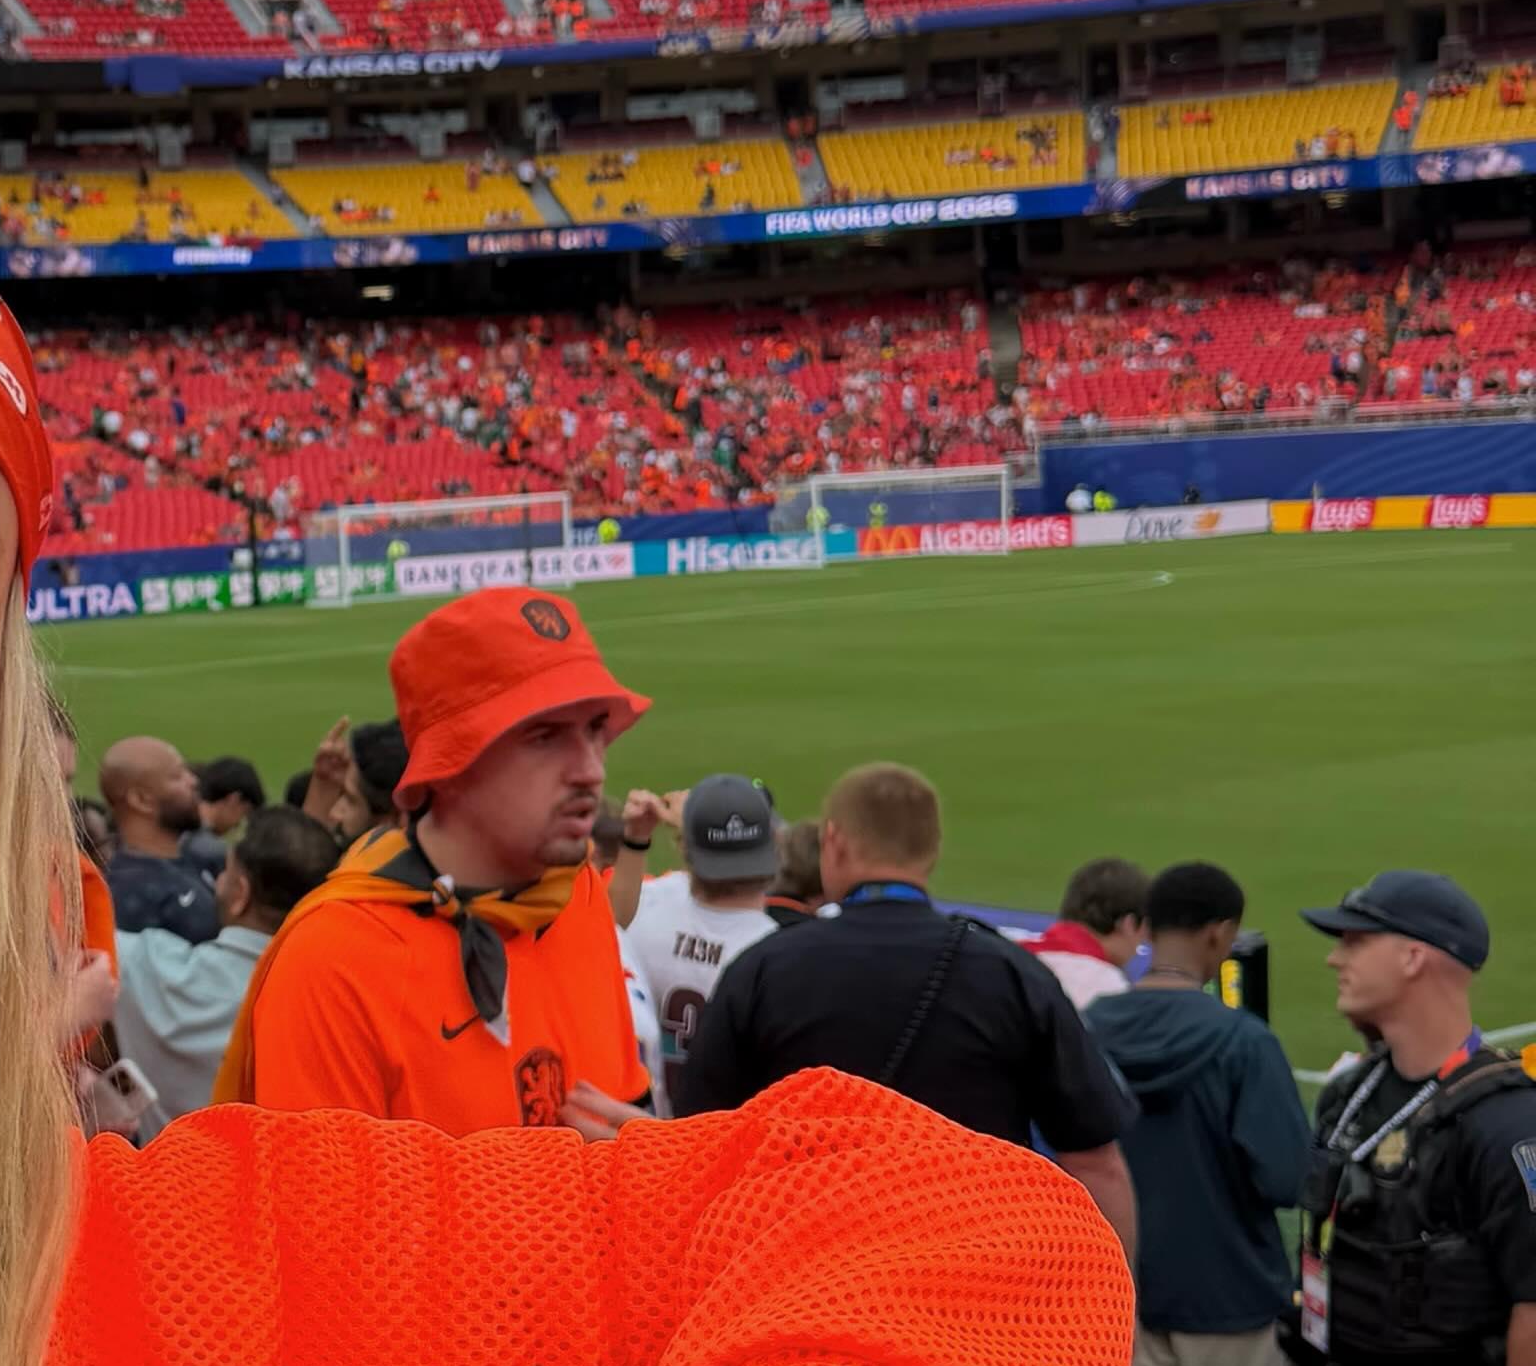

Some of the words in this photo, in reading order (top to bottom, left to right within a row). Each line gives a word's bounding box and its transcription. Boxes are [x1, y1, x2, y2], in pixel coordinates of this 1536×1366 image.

[284, 53, 420, 79] KANSAS
[423, 50, 503, 74] CITY
[1186, 168, 1286, 200] KANSAS
[1290, 165, 1349, 190] CITY
[766, 211, 812, 236] FIFA
[813, 204, 891, 232] WORLD
[891, 200, 936, 225] CUP
[937, 193, 1019, 221] 2026
[1124, 505, 1185, 543] Dove
[1312, 498, 1372, 532] Lay's
[1430, 494, 1489, 529] Lay's
[920, 515, 1071, 553] McDonald's
[403, 561, 462, 585] BANK
